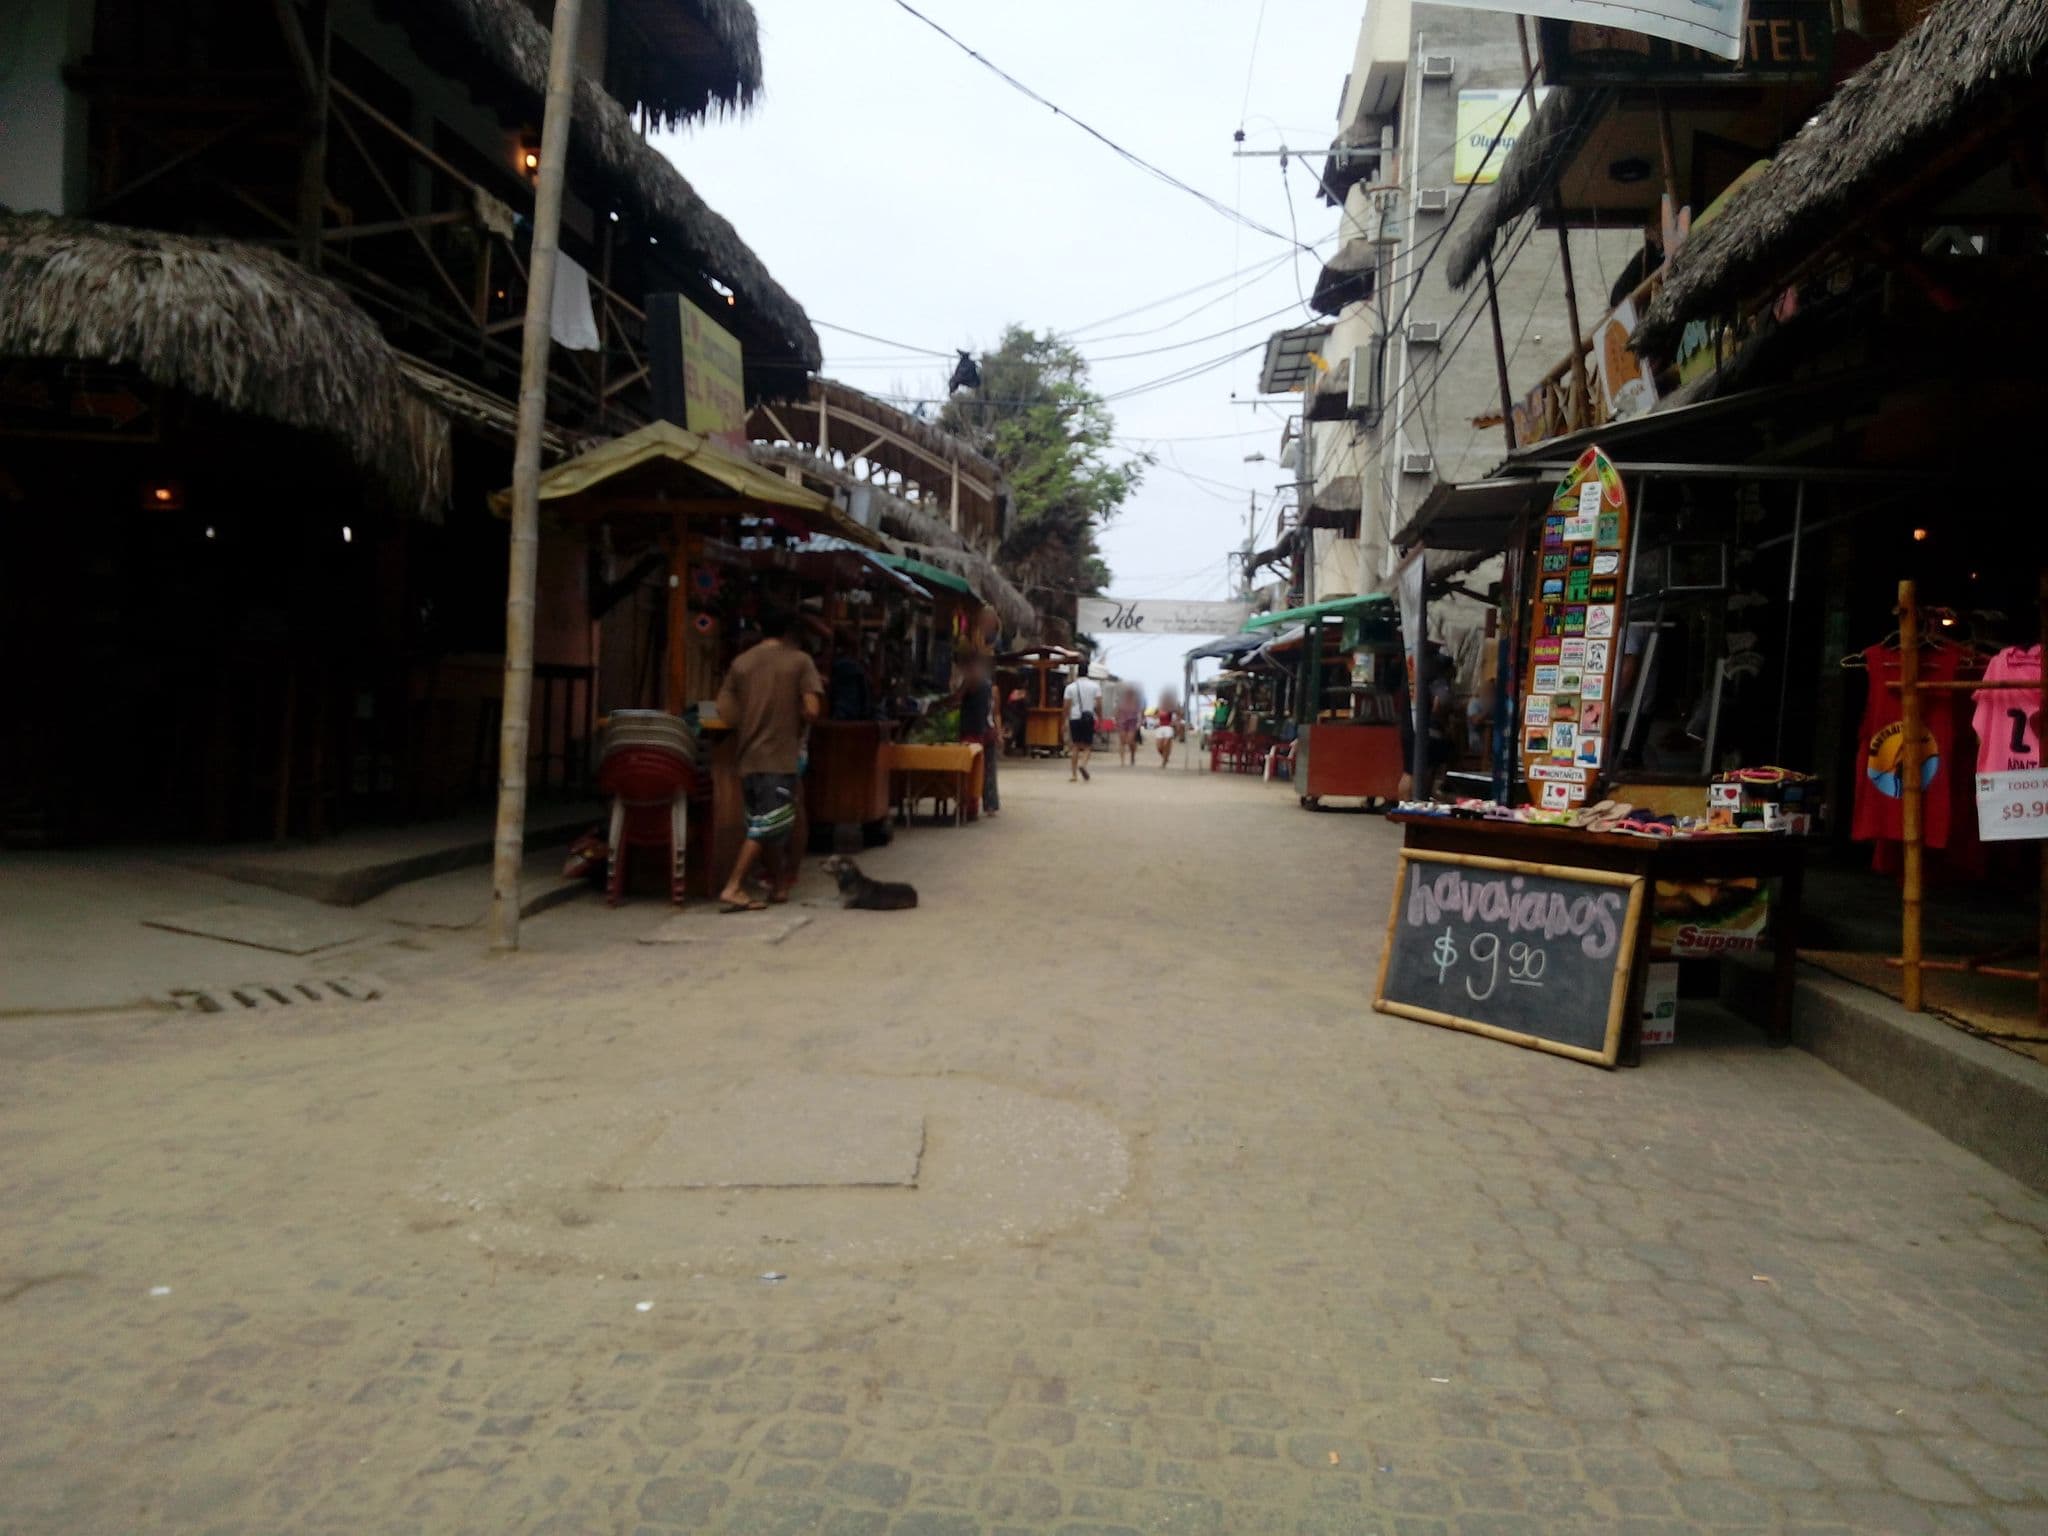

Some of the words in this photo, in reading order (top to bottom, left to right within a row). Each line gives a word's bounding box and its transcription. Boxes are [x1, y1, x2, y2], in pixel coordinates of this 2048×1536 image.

[1547, 785, 1553, 797] I
[2008, 779, 2039, 792] TODO
[2002, 801, 2048, 820] $9.9
